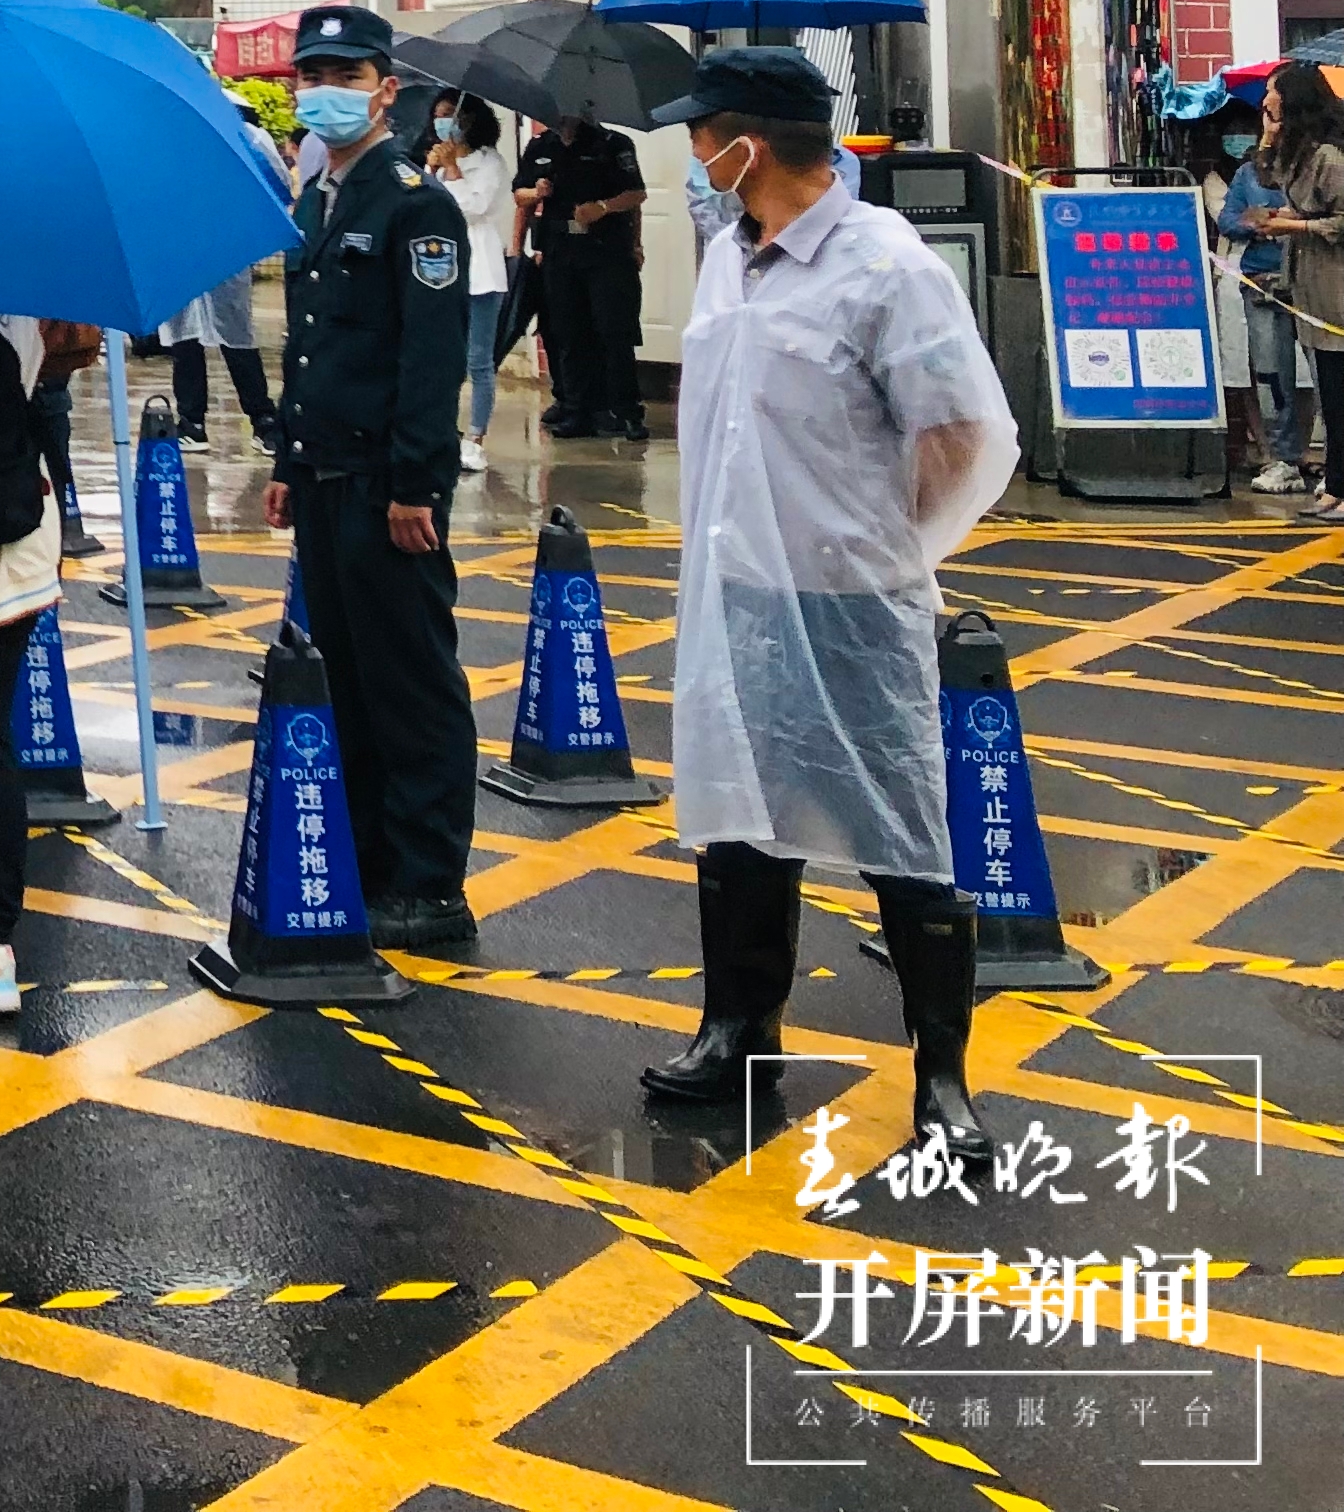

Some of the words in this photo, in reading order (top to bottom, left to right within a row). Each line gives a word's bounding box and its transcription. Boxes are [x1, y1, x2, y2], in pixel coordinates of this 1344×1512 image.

[560, 618, 604, 631] POLICE
[571, 631, 602, 729] 违停拖移
[961, 748, 1020, 764] POLICE
[280, 766, 338, 781] POLICE
[979, 764, 1013, 887] 禁止停车
[294, 782, 331, 908] 违停拖移
[286, 910, 348, 929] 交警提示
